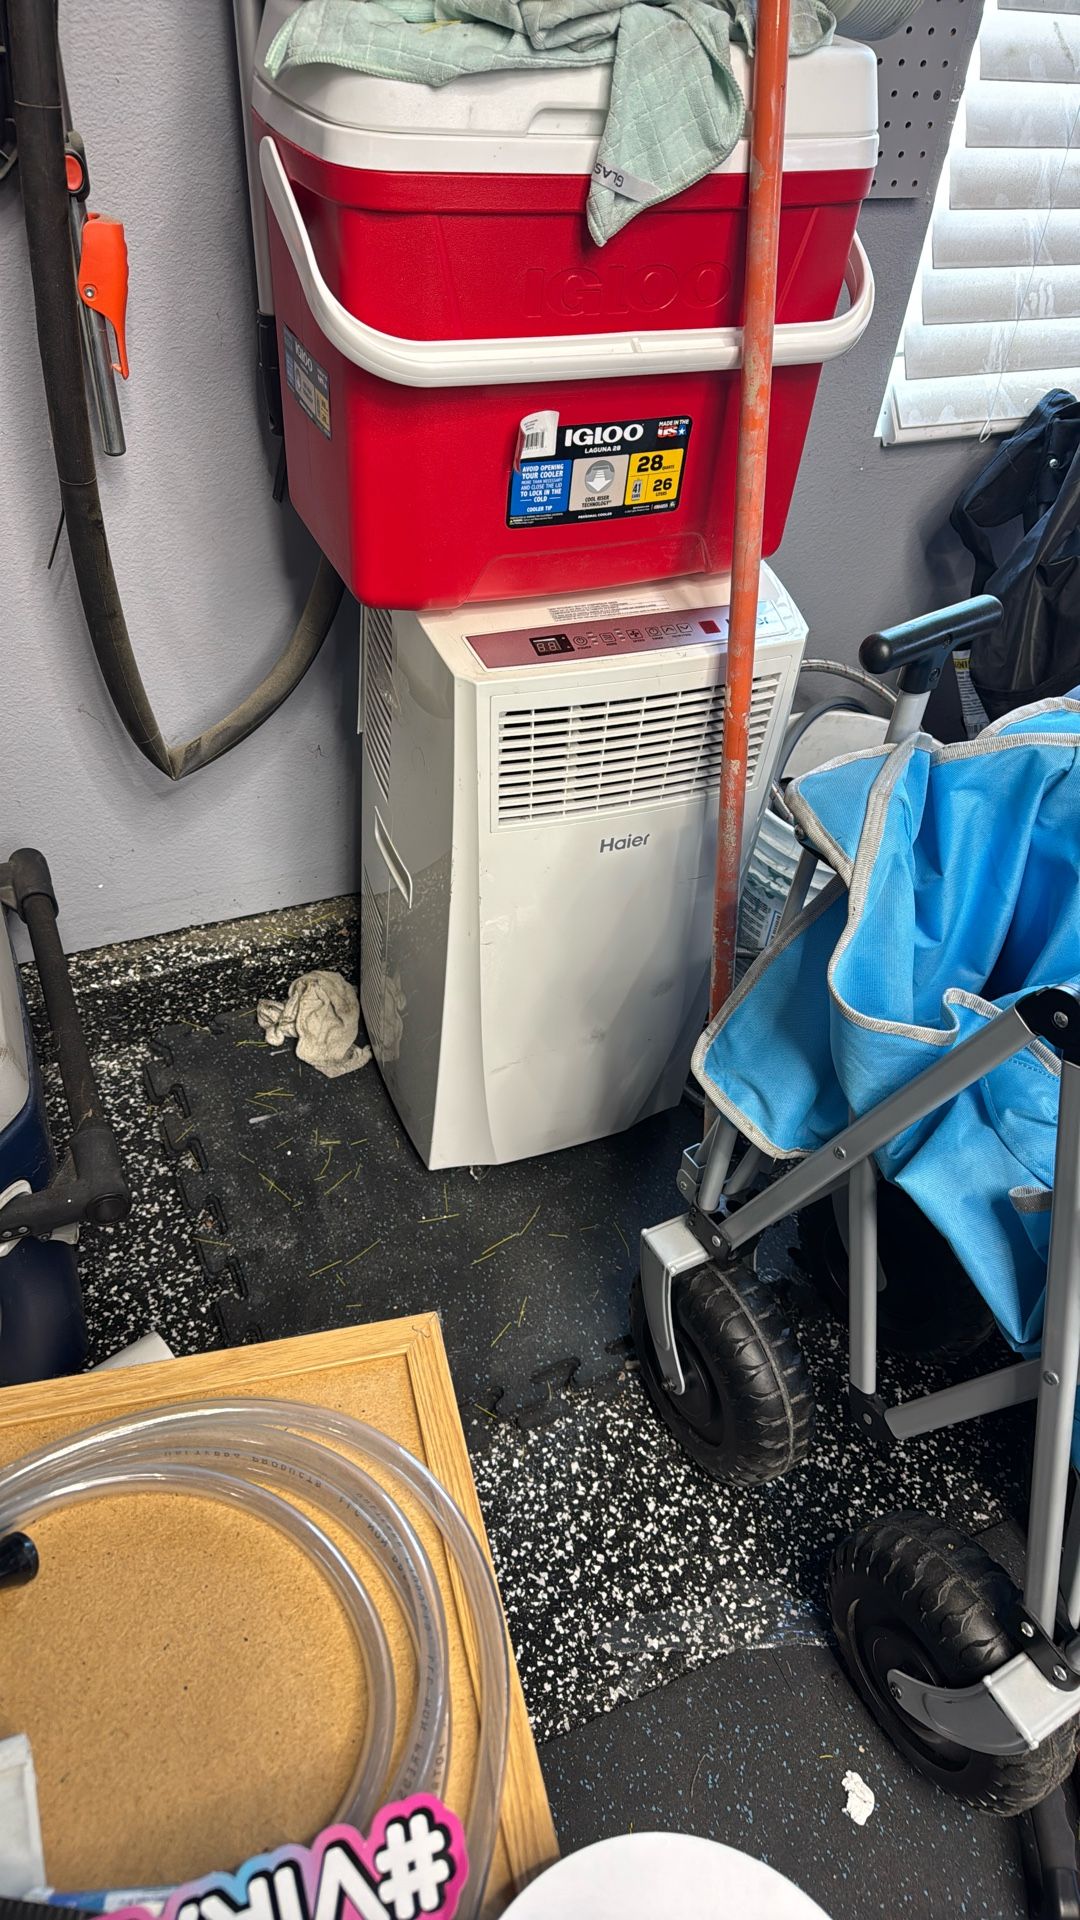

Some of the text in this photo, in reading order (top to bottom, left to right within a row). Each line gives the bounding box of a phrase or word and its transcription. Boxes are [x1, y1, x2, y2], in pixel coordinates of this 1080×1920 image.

[523, 261, 732, 318] IGLOO
[564, 424, 644, 447] IGLOO
[584, 446, 611, 454] LAGUNA
[522, 463, 564, 473] AVOID OPENING
[637, 454, 663, 473] 28
[522, 470, 563, 480] YOUR COOLER
[653, 477, 672, 492] 26
[581, 500, 609, 508] TECHNOLOGY
[600, 833, 650, 853] Haier
